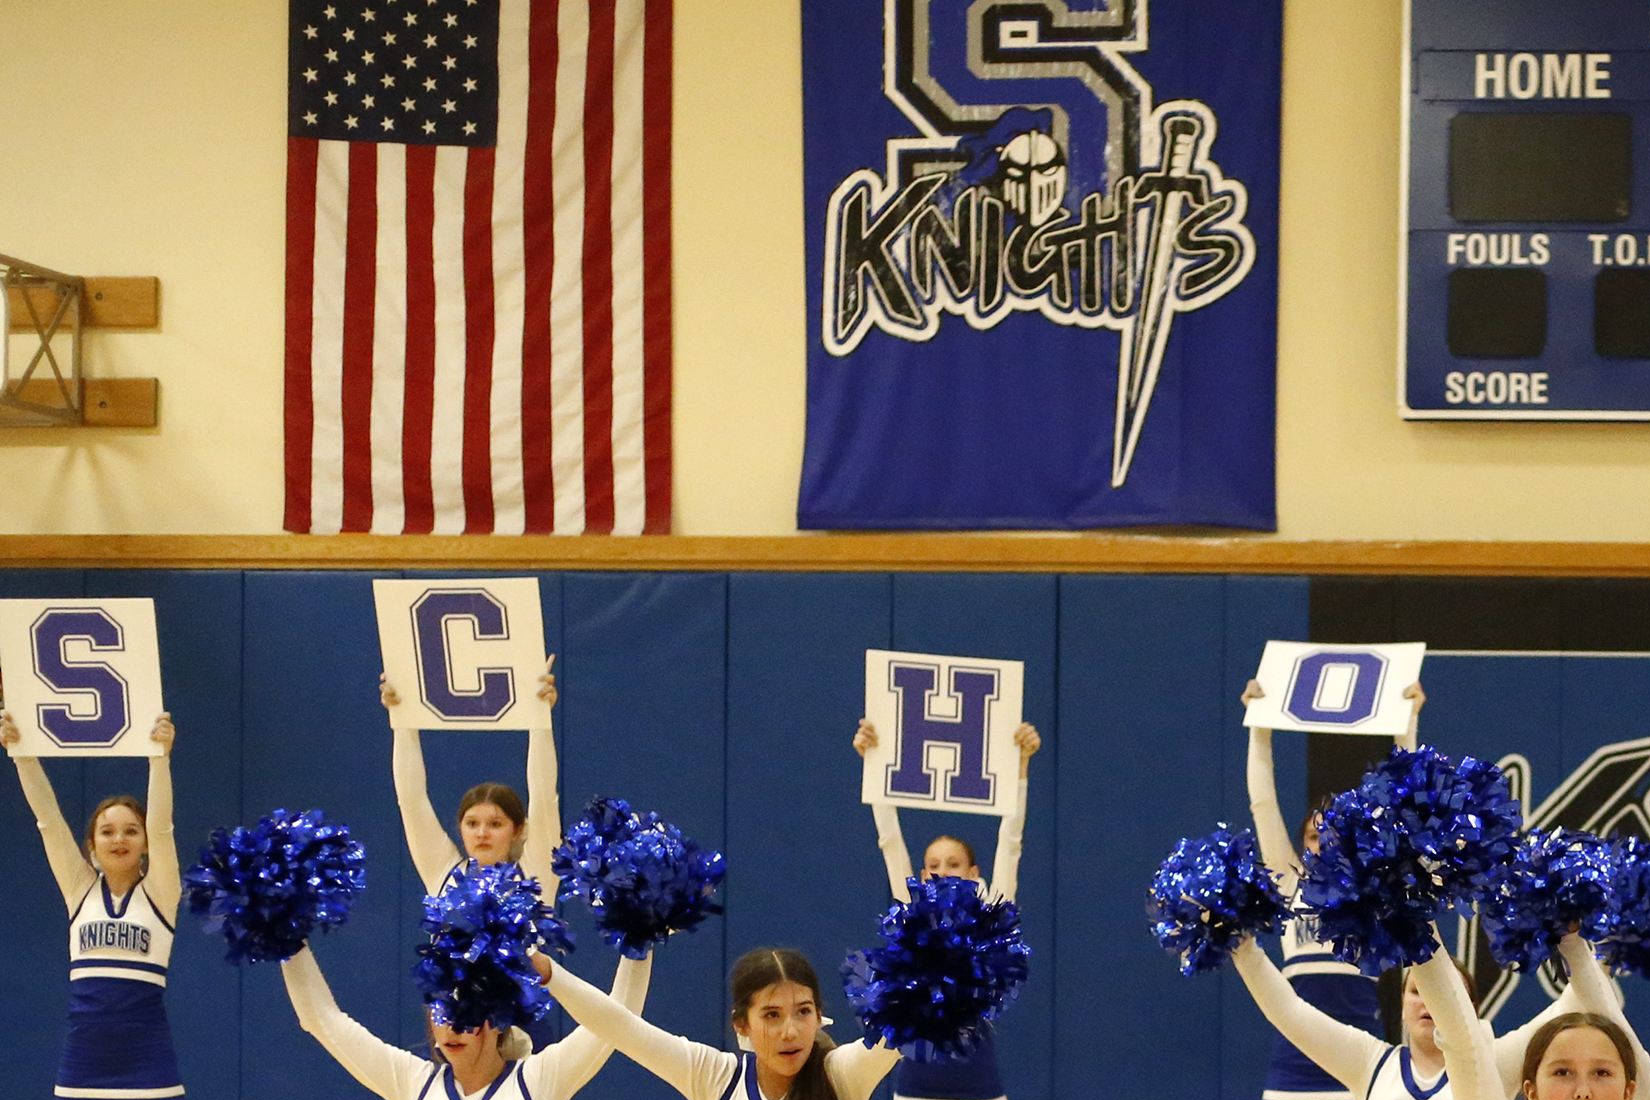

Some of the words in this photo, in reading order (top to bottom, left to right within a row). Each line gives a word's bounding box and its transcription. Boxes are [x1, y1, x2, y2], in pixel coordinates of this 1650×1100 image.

[1474, 53, 1612, 99] HOME
[1447, 233, 1550, 266] FOULS
[1445, 371, 1549, 404] SCORE
[29, 607, 131, 748] S
[410, 587, 516, 722] C
[1281, 649, 1390, 727] O
[885, 659, 1003, 807] H
[79, 920, 151, 956] KNIGHTS
